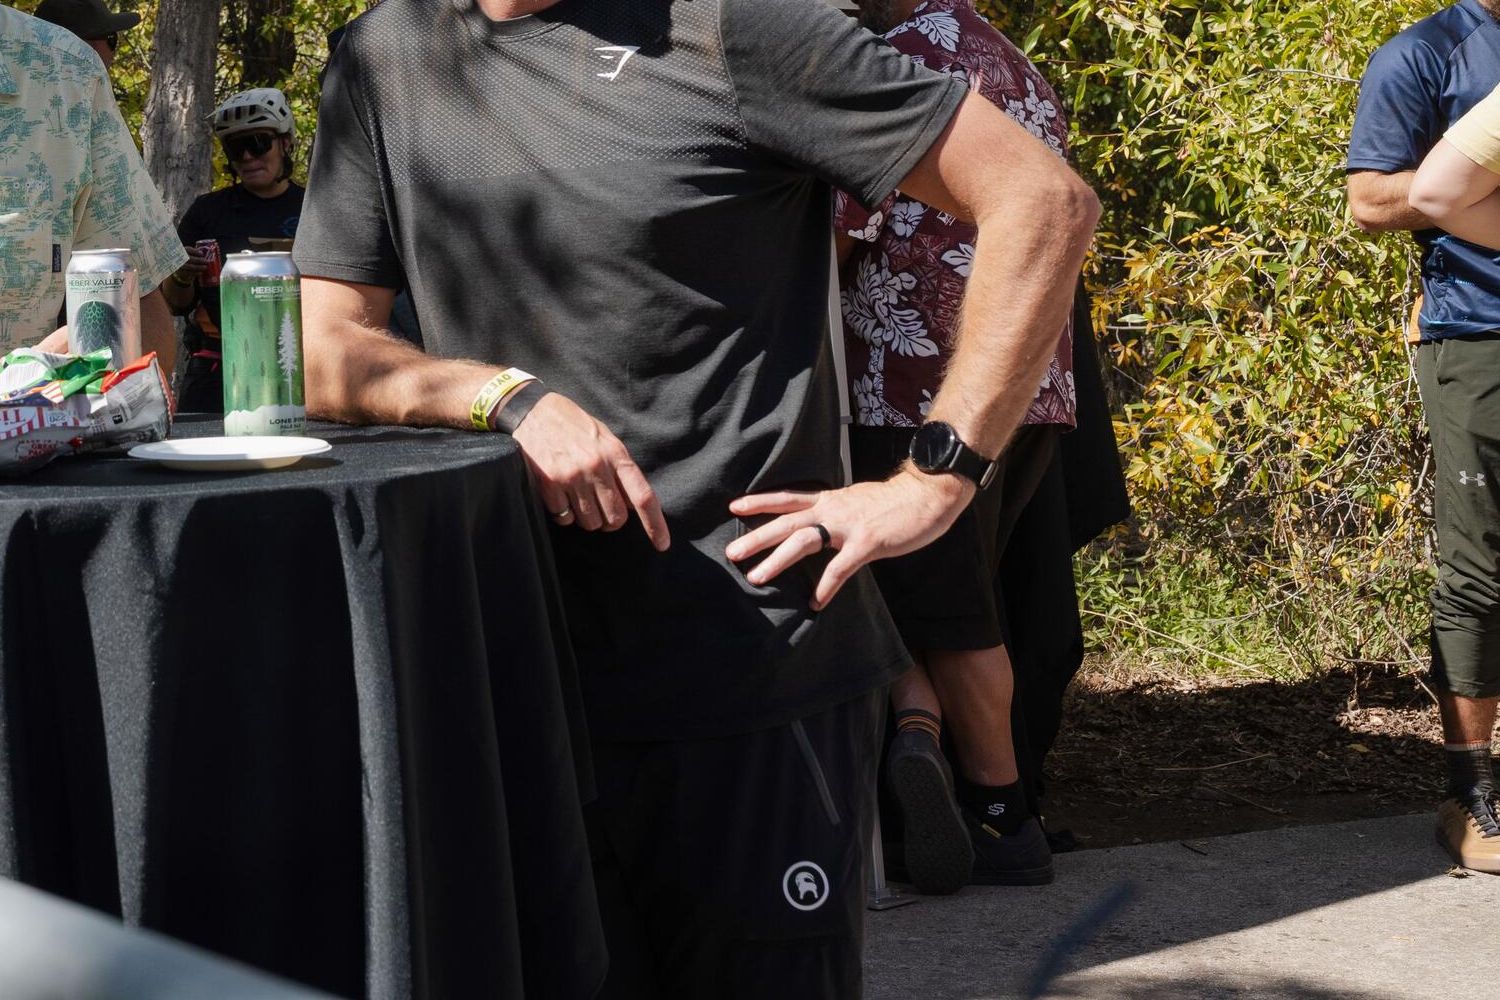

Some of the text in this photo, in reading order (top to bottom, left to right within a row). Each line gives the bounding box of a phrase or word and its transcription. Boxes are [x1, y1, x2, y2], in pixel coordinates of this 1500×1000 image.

[92, 278, 125, 286] VALLEY
[251, 286, 283, 295] HEBER
[484, 374, 512, 395] OVER
[269, 417, 293, 425] LONE
